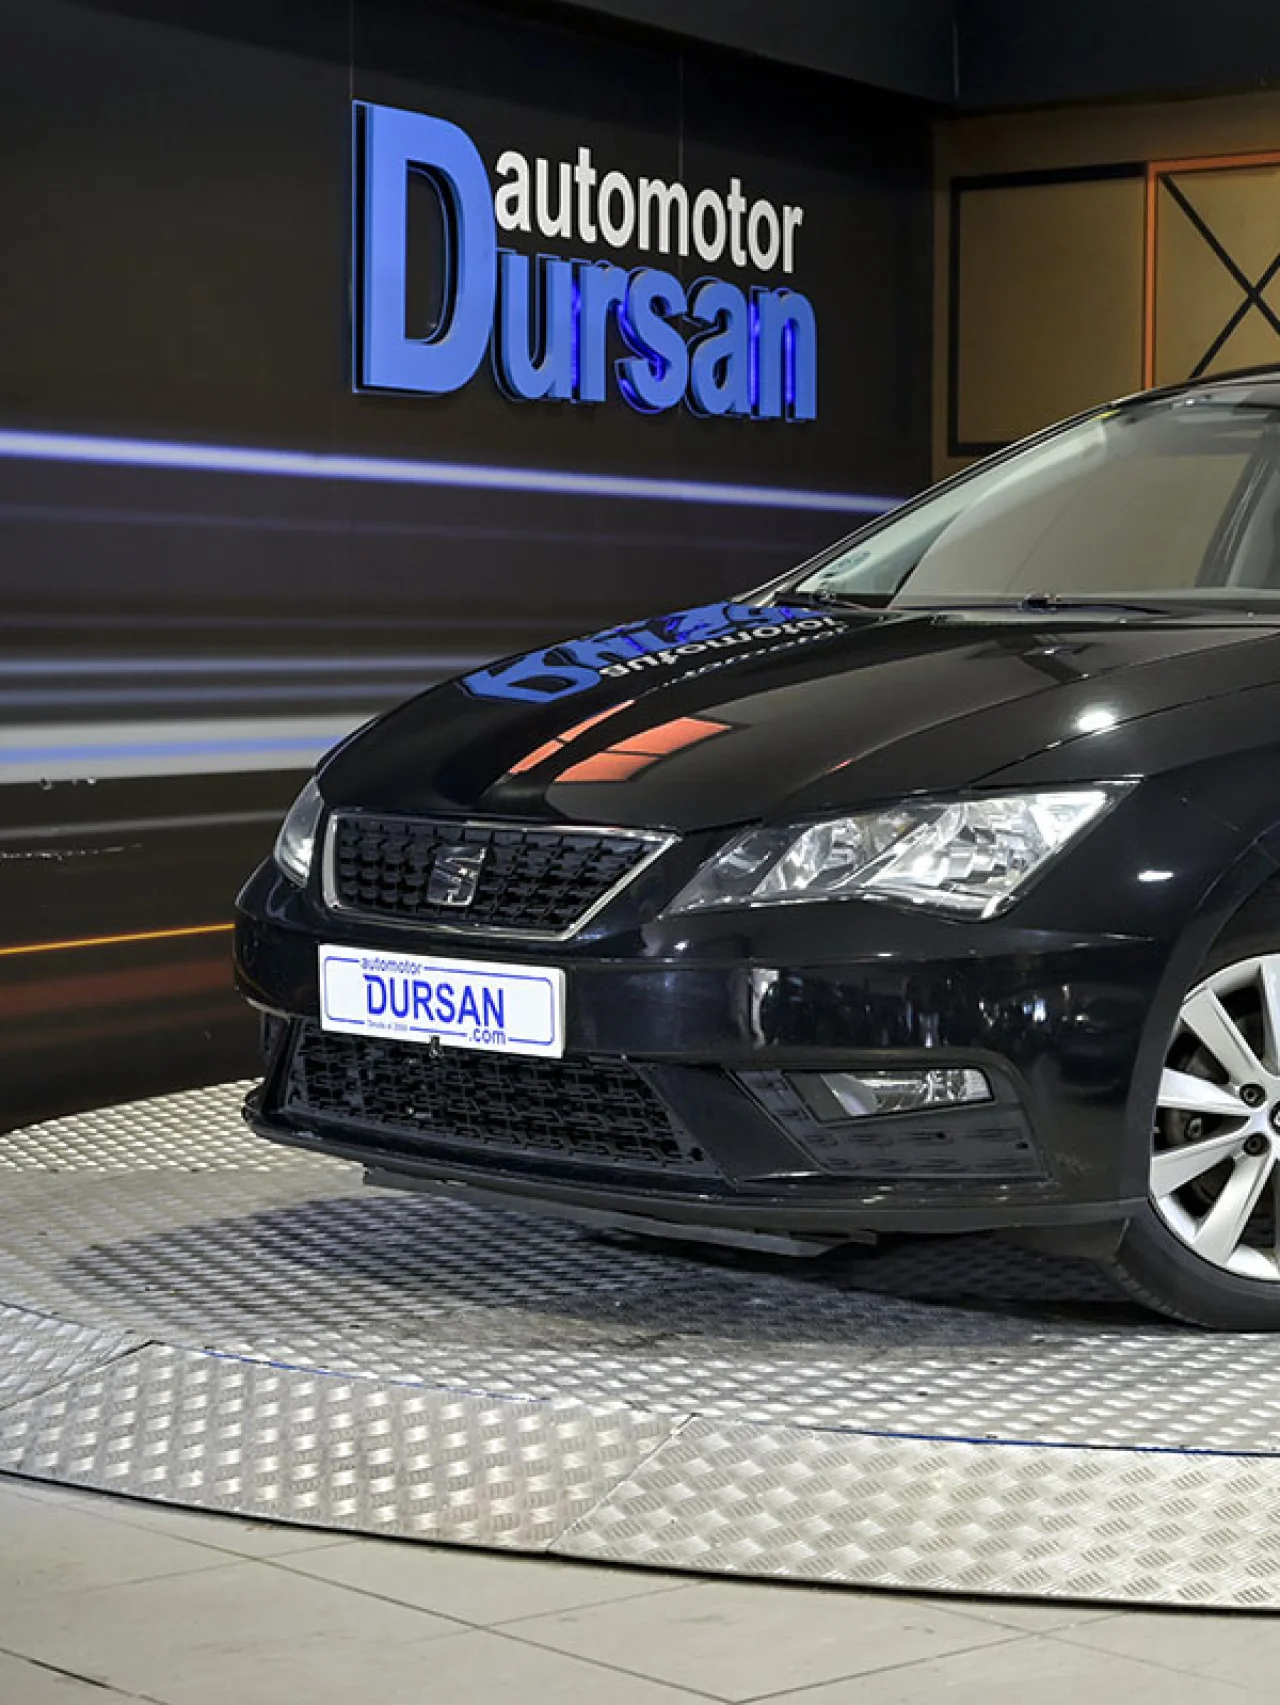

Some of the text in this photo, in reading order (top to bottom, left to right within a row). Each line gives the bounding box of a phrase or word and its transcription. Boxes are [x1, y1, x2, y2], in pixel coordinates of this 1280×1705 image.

[495, 147, 803, 273] automotor
[353, 100, 816, 421] Dursan
[364, 975, 504, 1028] DURSAN
[469, 1027, 506, 1044] .com
